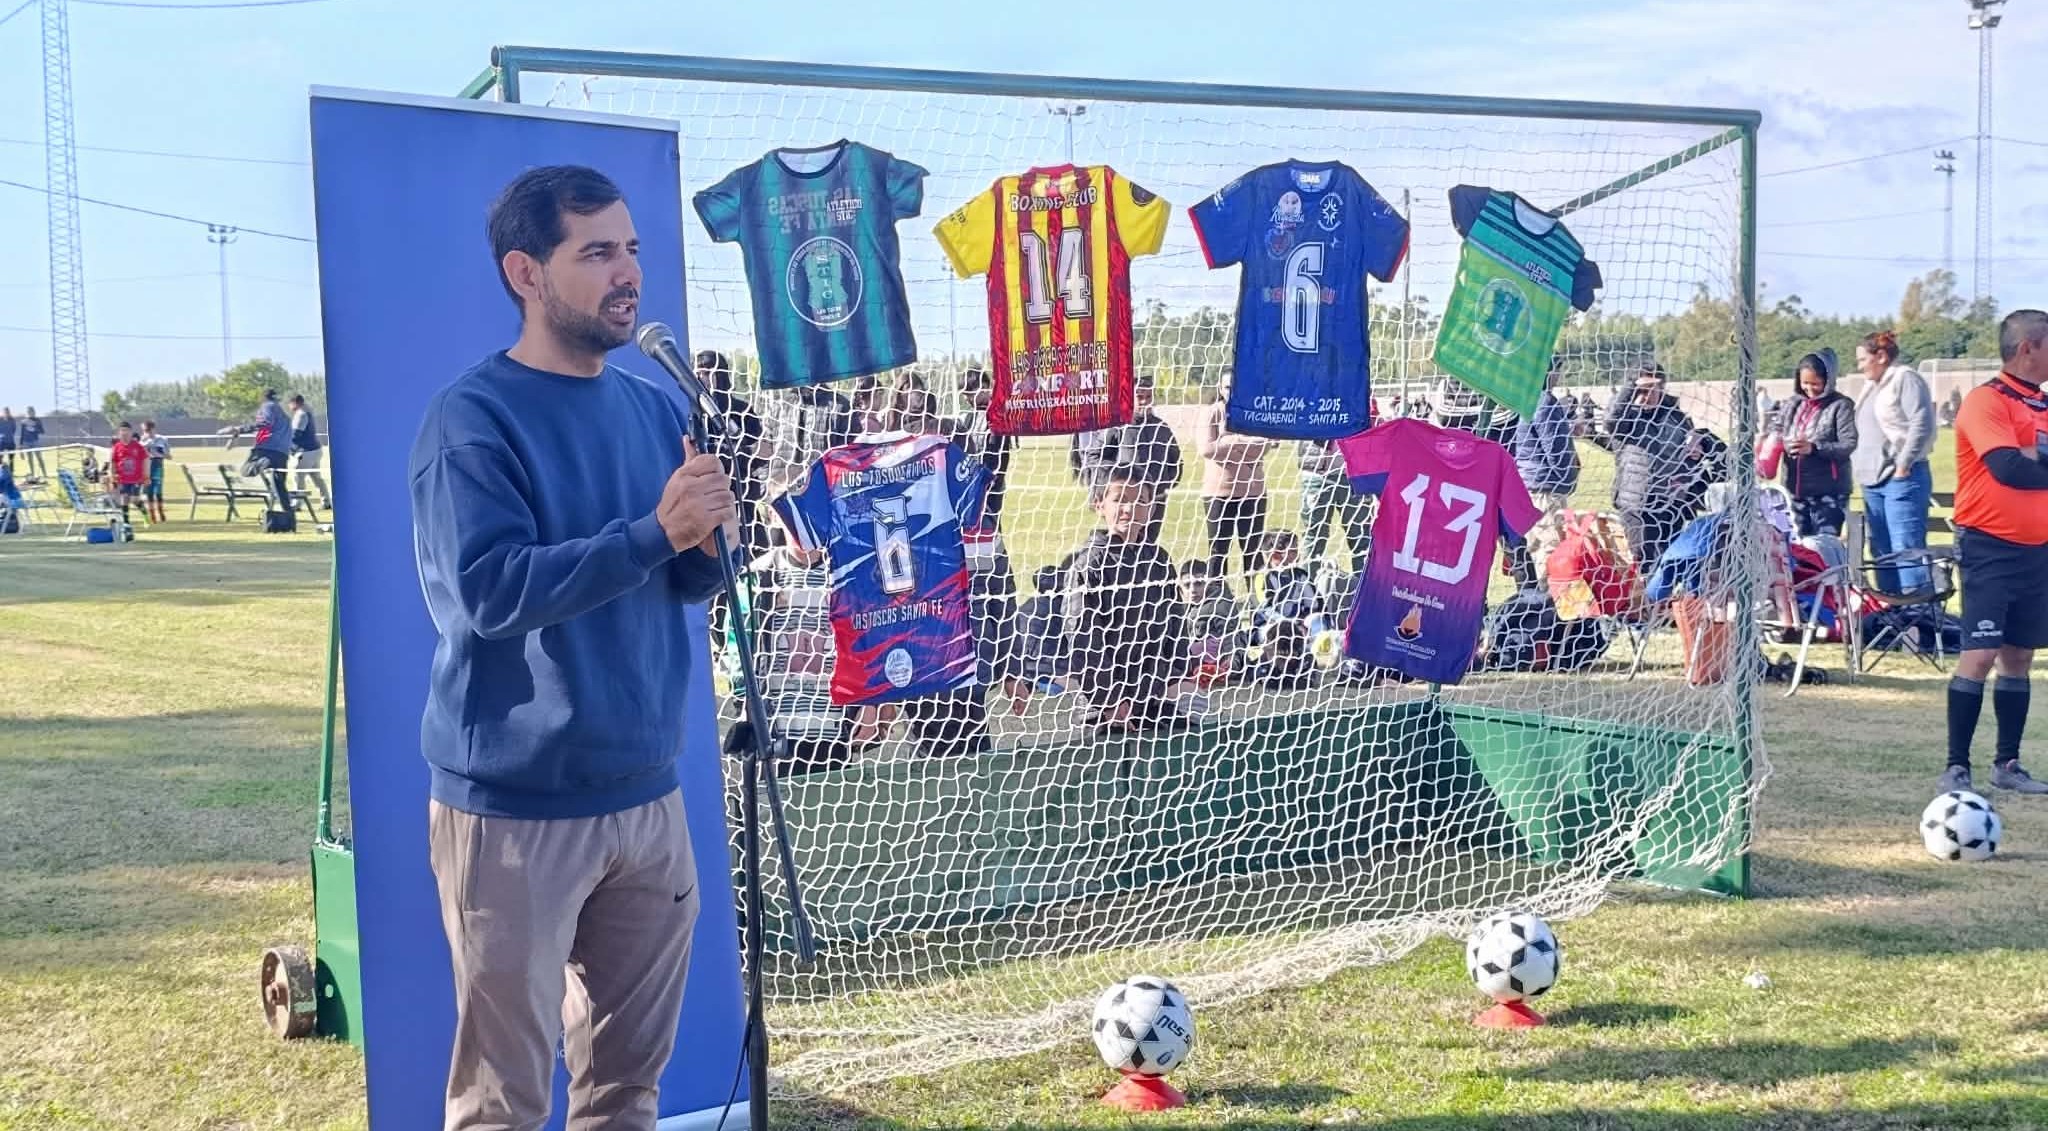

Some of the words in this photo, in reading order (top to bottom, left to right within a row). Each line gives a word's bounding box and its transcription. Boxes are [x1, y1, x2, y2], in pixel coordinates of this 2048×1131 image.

[1009, 193, 1064, 212] BOXING
[1065, 186, 1097, 208] CLUB
[1018, 225, 1092, 324] 14
[1282, 242, 1324, 353] 6
[1254, 396, 1277, 411] CAT.
[1280, 397, 1306, 411] 2014
[1318, 398, 1341, 411] 2015
[1308, 413, 1338, 425] SANTA
[1339, 413, 1349, 424] FE
[841, 471, 862, 488] LOS
[1393, 473, 1487, 585] 13
[872, 495, 914, 595] 6
[901, 602, 927, 621] SANTA
[931, 598, 943, 616] FE
